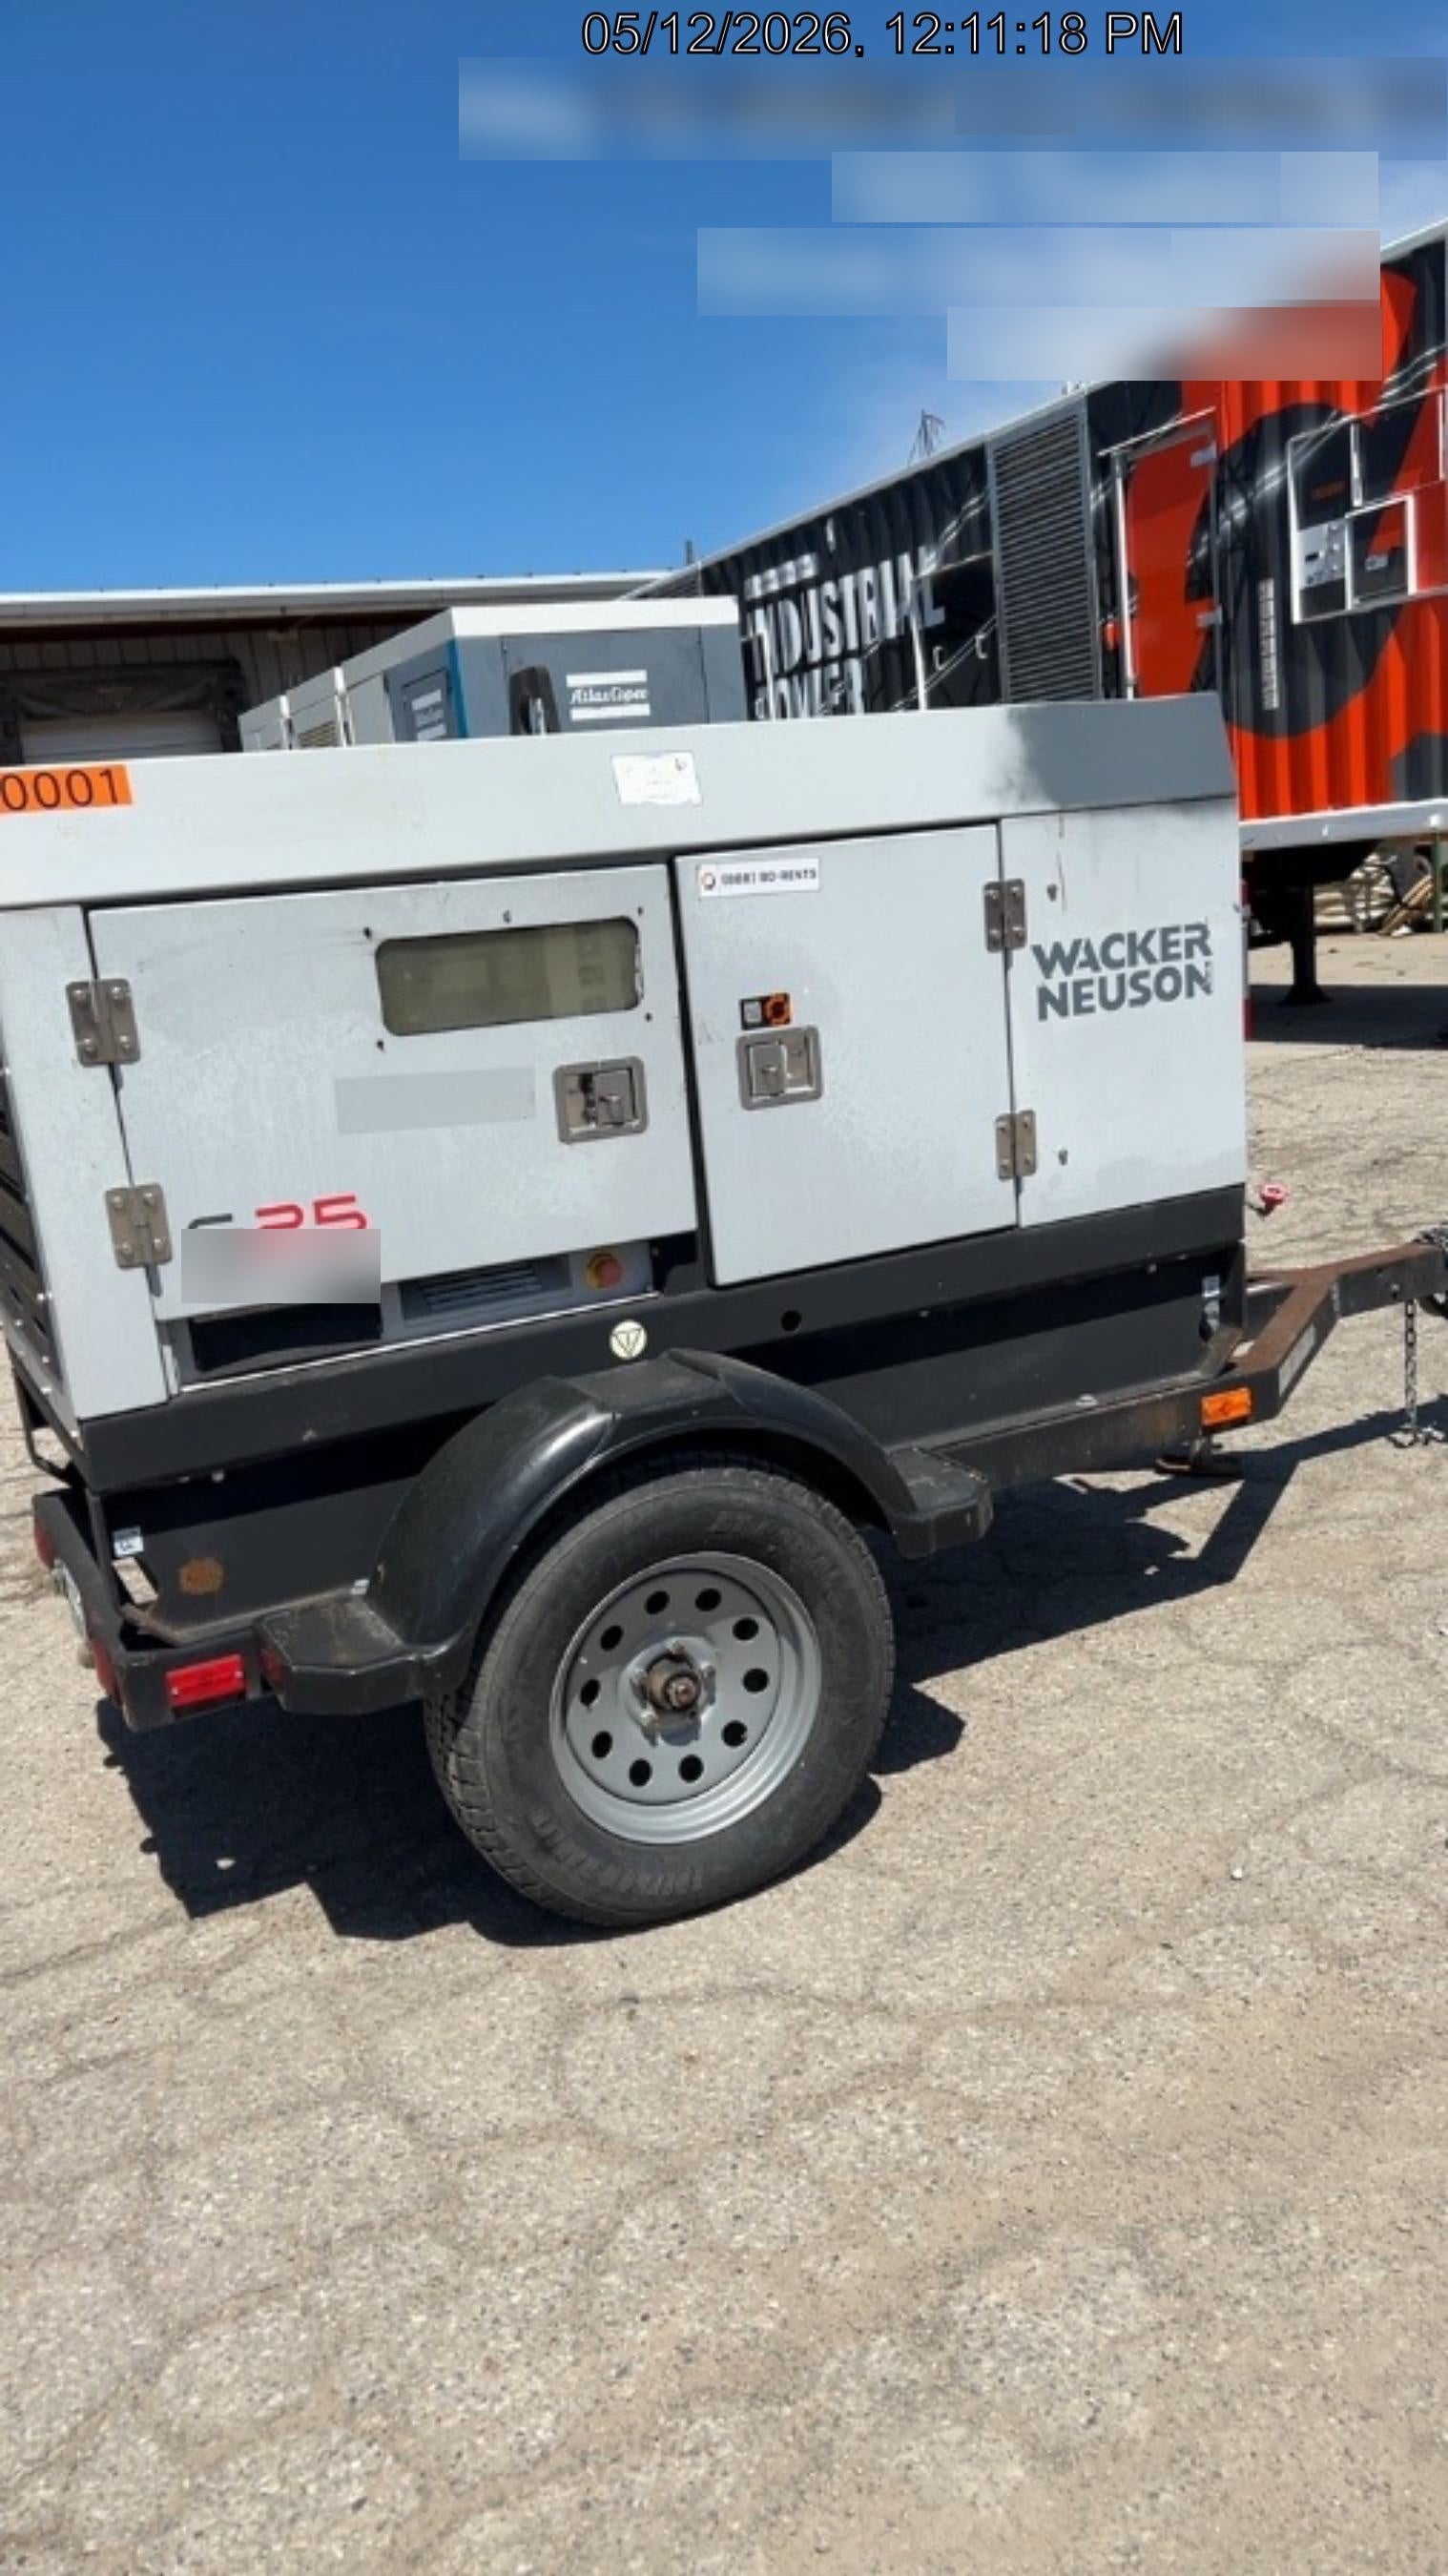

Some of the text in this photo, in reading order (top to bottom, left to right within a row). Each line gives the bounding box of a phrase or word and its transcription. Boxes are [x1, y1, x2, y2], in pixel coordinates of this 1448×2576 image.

[745, 545, 945, 681] INDUSTRIAL
[1030, 922, 1212, 979] WACKER
[1038, 961, 1212, 1023] NEUSON
